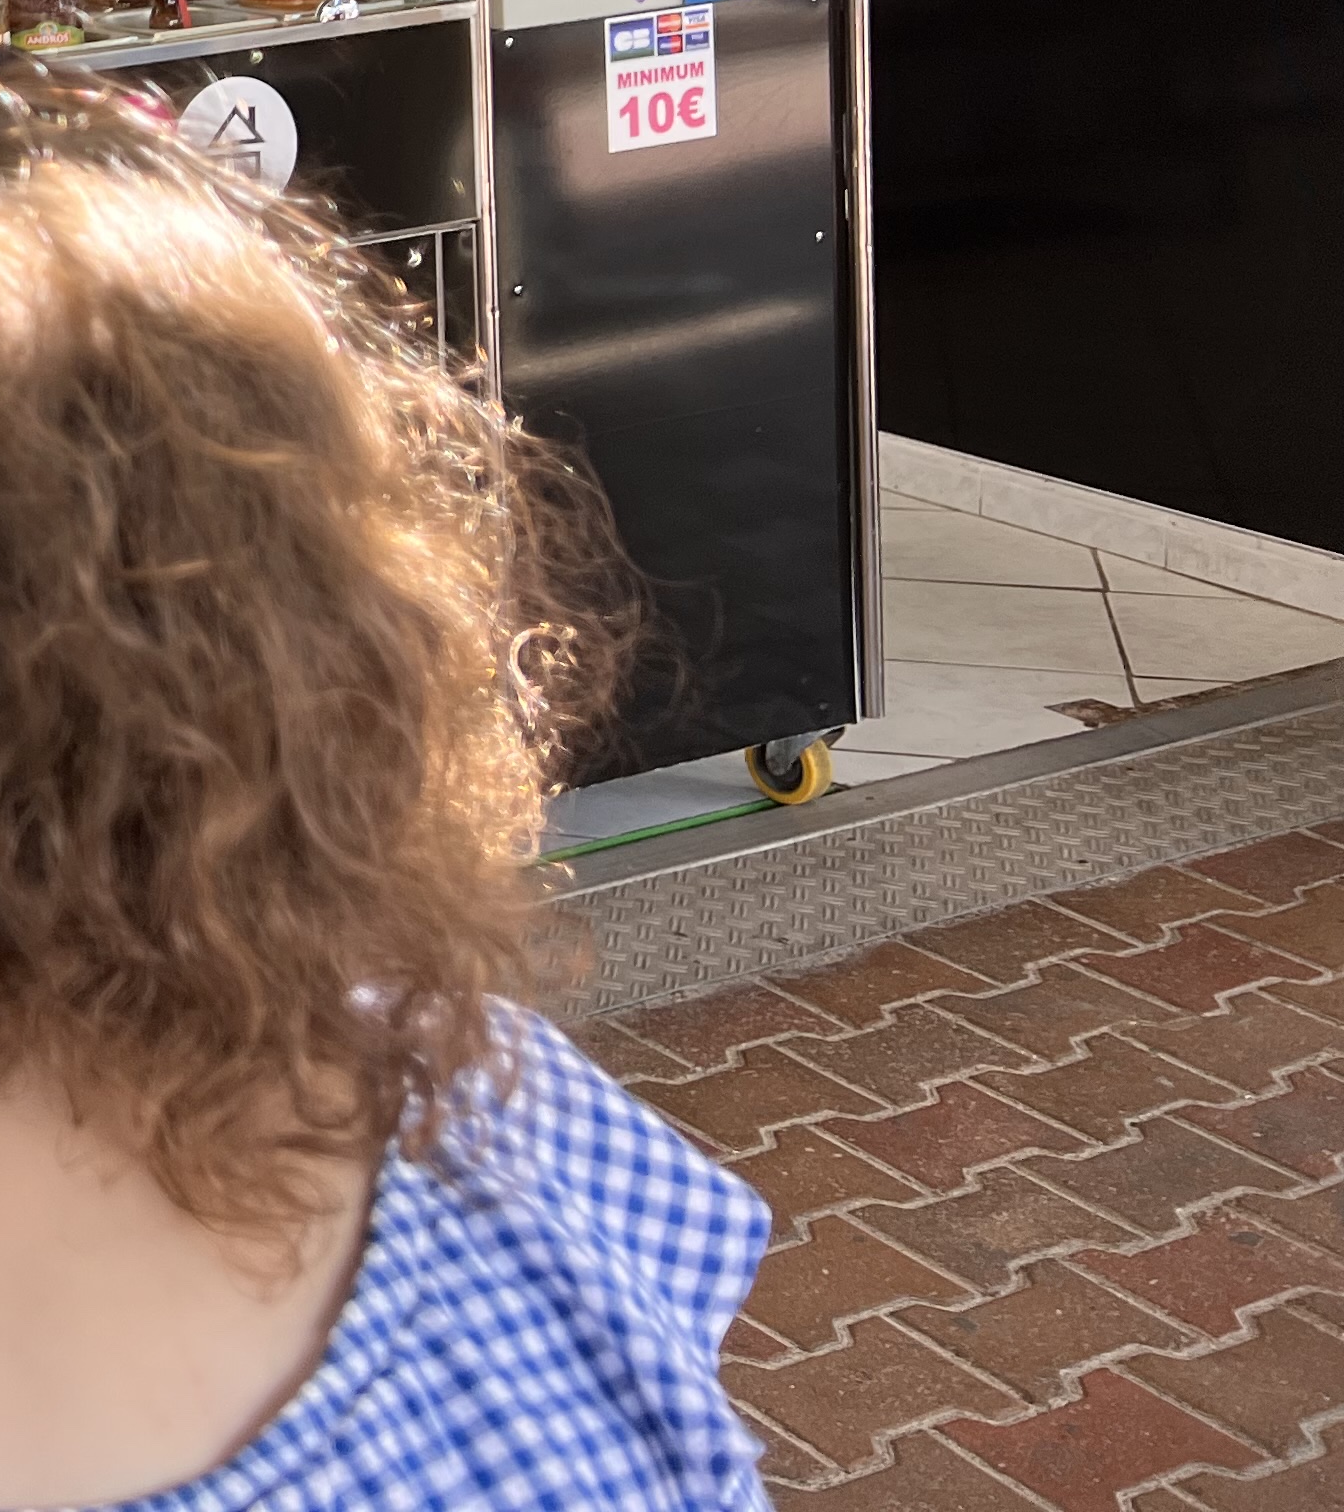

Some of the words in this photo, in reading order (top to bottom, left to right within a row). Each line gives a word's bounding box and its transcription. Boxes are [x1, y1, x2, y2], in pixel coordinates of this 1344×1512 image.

[27, 35, 69, 45] ANDROS
[618, 61, 704, 89] MINIMUM
[620, 87, 705, 138] 10€
